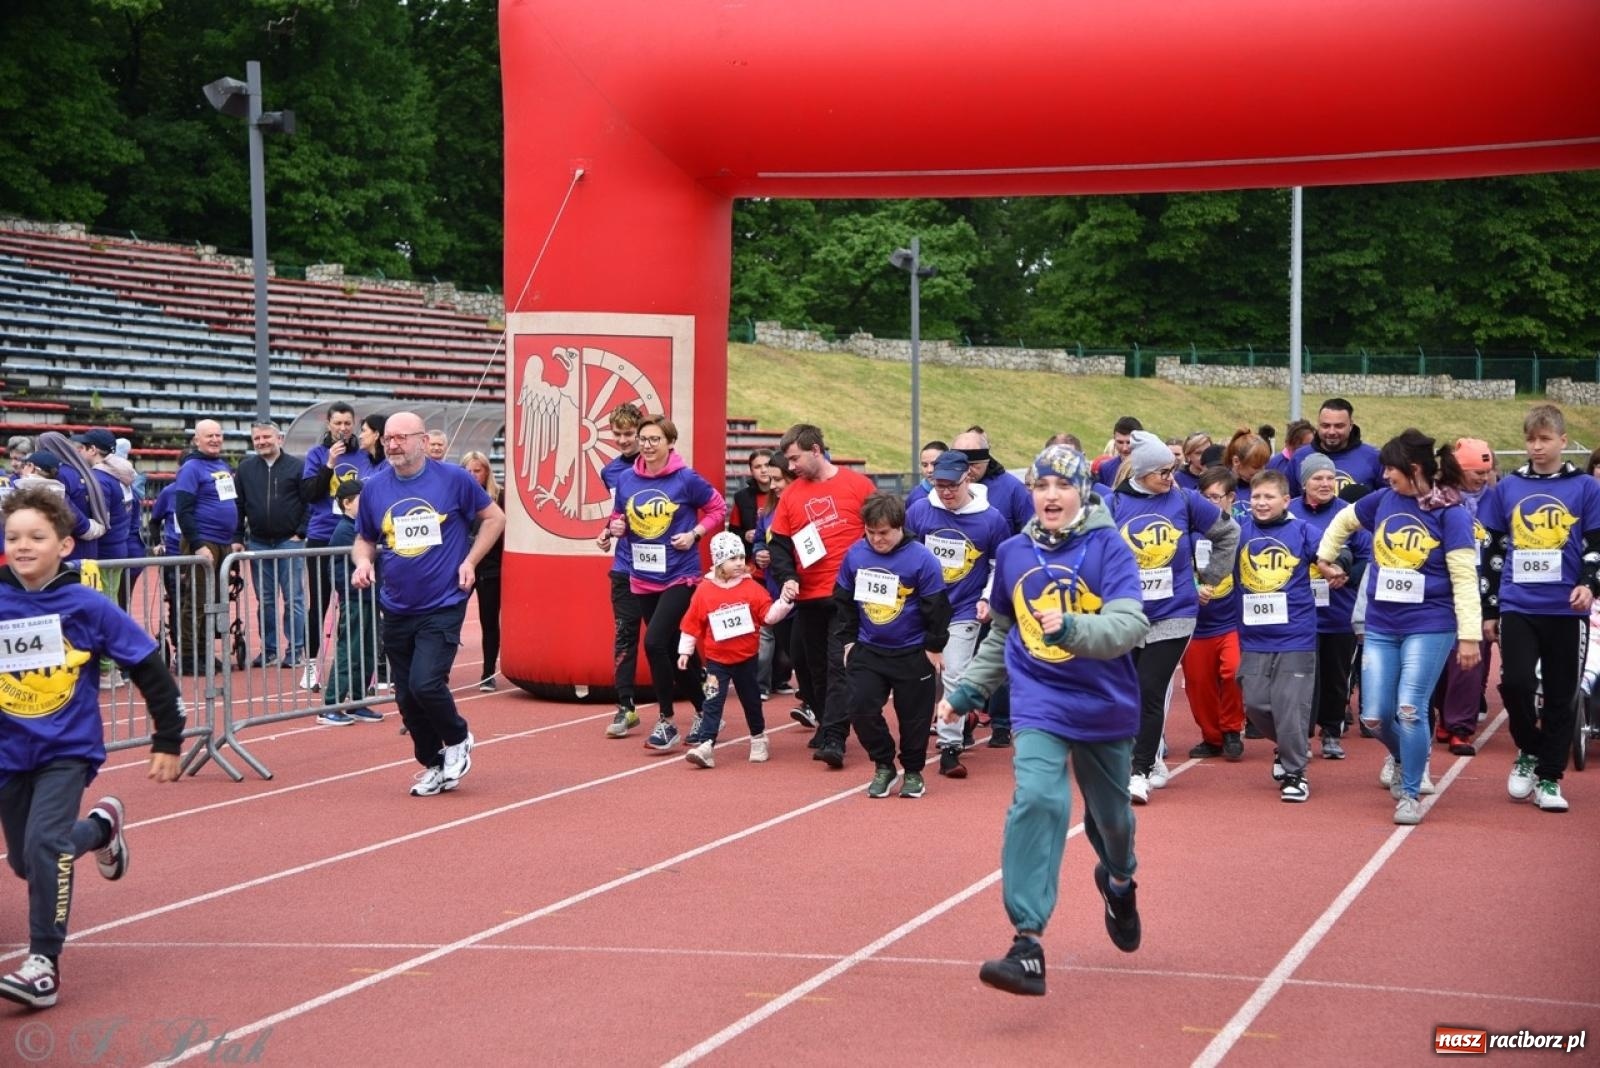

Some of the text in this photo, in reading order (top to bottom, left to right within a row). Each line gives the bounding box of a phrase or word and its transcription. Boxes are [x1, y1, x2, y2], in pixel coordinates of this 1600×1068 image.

[405, 524, 430, 538] 070
[803, 536, 816, 555] 128
[639, 553, 658, 563] 054
[933, 546, 956, 559] 029
[1523, 560, 1550, 571] 085
[867, 582, 888, 595] 158
[1386, 578, 1413, 591] 089
[1253, 603, 1274, 614] 081
[722, 616, 742, 629] 132
[3, 634, 44, 655] 164
